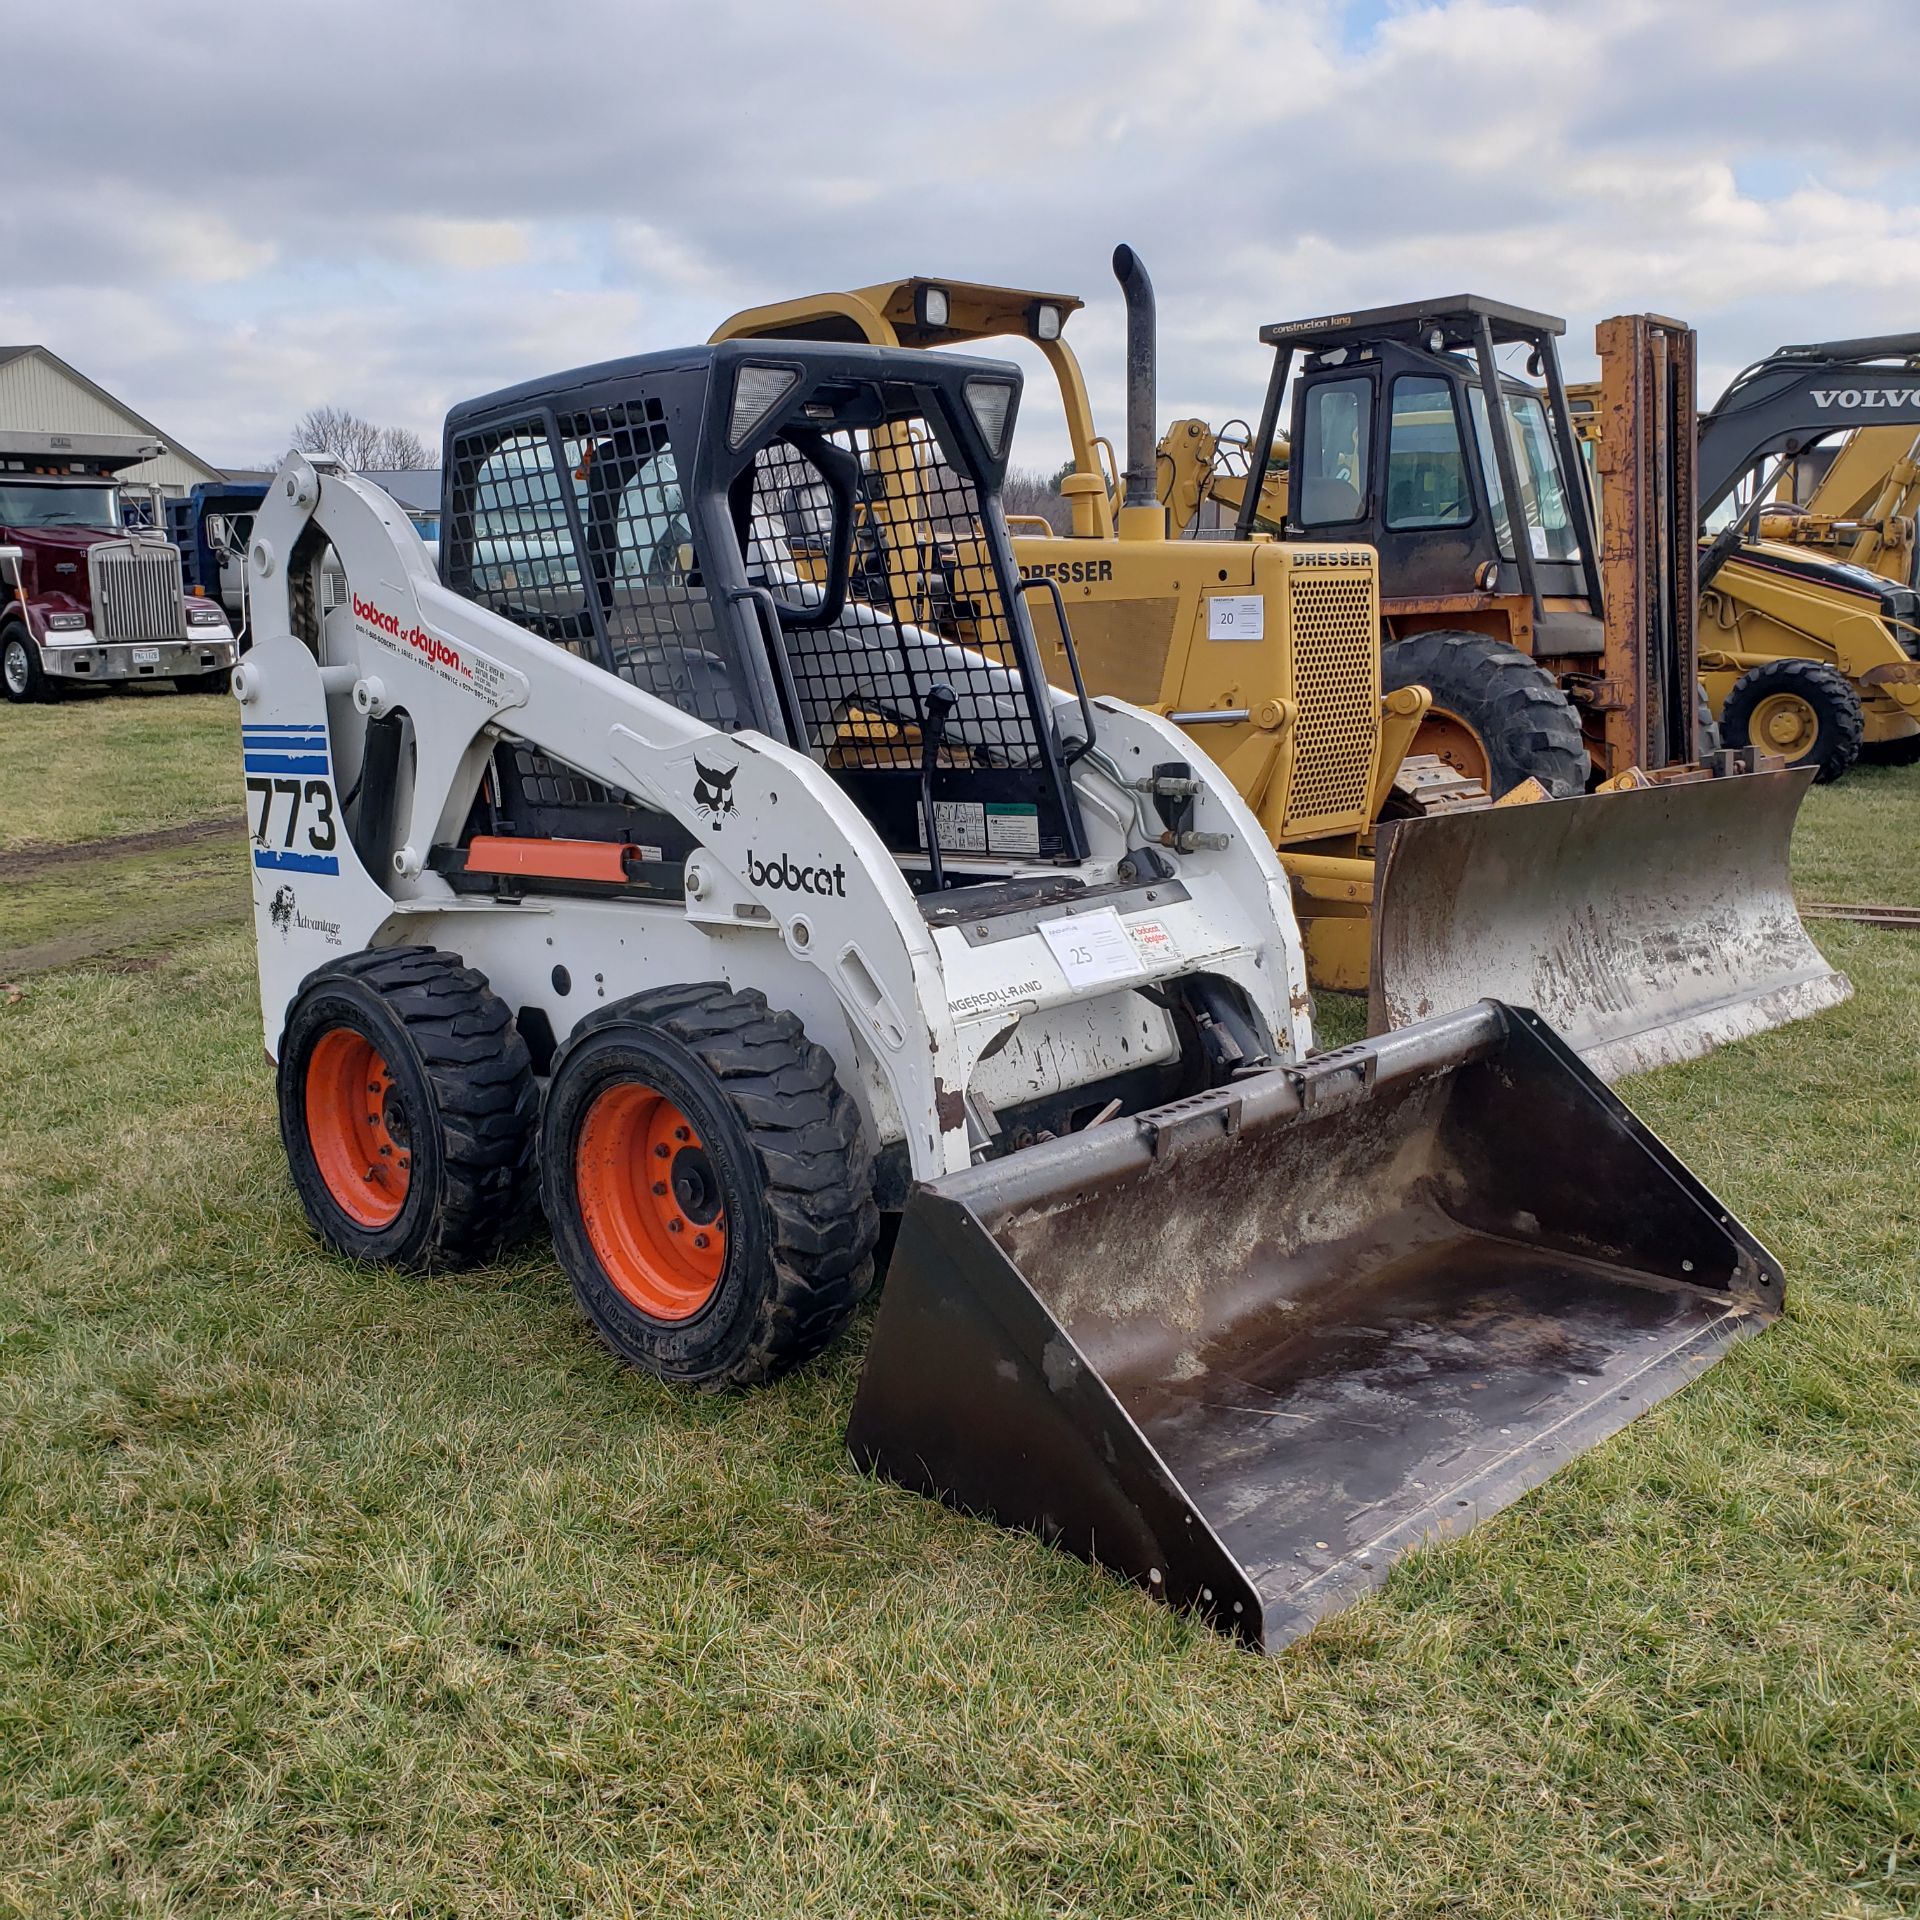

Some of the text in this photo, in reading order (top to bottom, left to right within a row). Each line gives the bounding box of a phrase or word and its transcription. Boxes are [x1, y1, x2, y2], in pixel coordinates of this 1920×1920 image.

[1272, 318, 1328, 334] construction
[1293, 552, 1371, 566] DRESSER
[1221, 612, 1234, 625] 20
[353, 592, 474, 680] bobcat of dayton inc.
[440, 669, 458, 686] SERVICE
[247, 777, 336, 851] 773
[747, 848, 846, 898] bobcat
[293, 912, 341, 936] Advantage
[1070, 946, 1093, 965] 25
[948, 980, 1042, 1012] NGERSOLL-RAND
